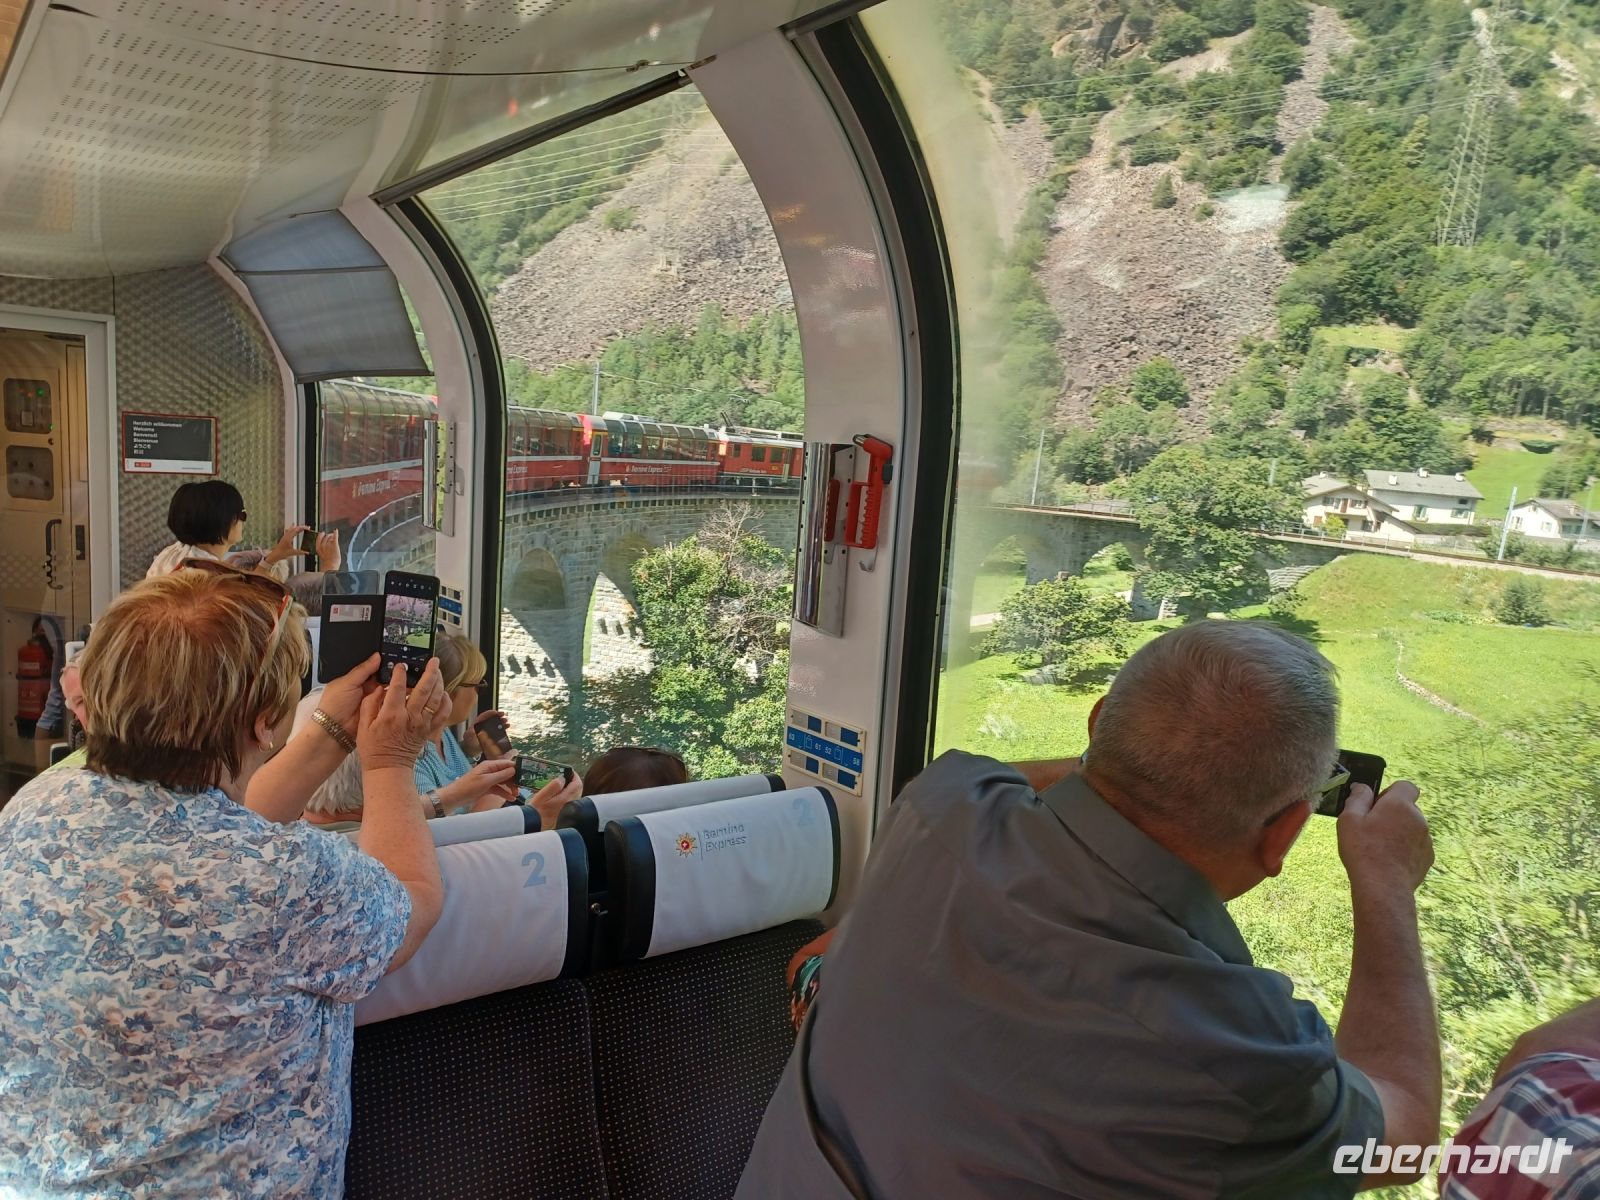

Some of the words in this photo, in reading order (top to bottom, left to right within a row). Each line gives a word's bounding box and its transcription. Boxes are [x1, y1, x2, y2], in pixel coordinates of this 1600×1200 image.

[814, 743, 821, 751] 61
[824, 747, 832, 755] 52
[703, 823, 745, 840] Bernina
[705, 836, 747, 852] Express
[521, 851, 546, 889] 2
